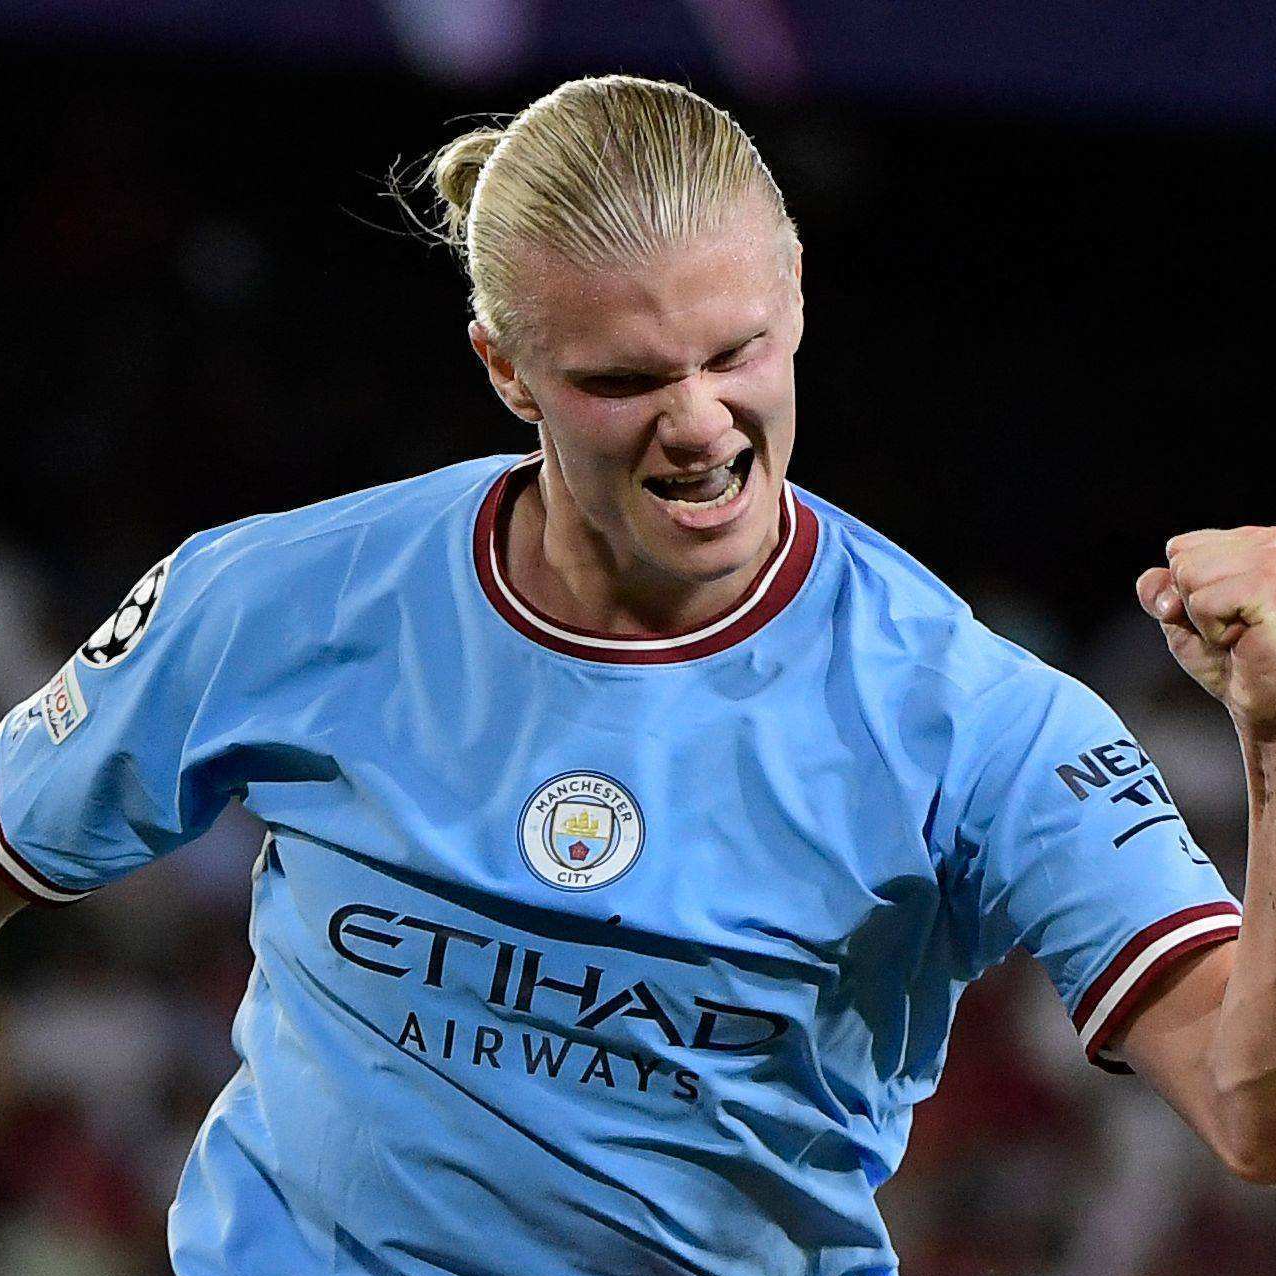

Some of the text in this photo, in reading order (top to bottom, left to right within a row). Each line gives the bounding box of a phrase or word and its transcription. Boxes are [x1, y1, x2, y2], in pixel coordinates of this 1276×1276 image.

[535, 780, 633, 823] MANCHESTER
[557, 871, 593, 884] CITY
[328, 903, 790, 1050] ETIHAD
[396, 1011, 700, 1101] AIRWAYS
